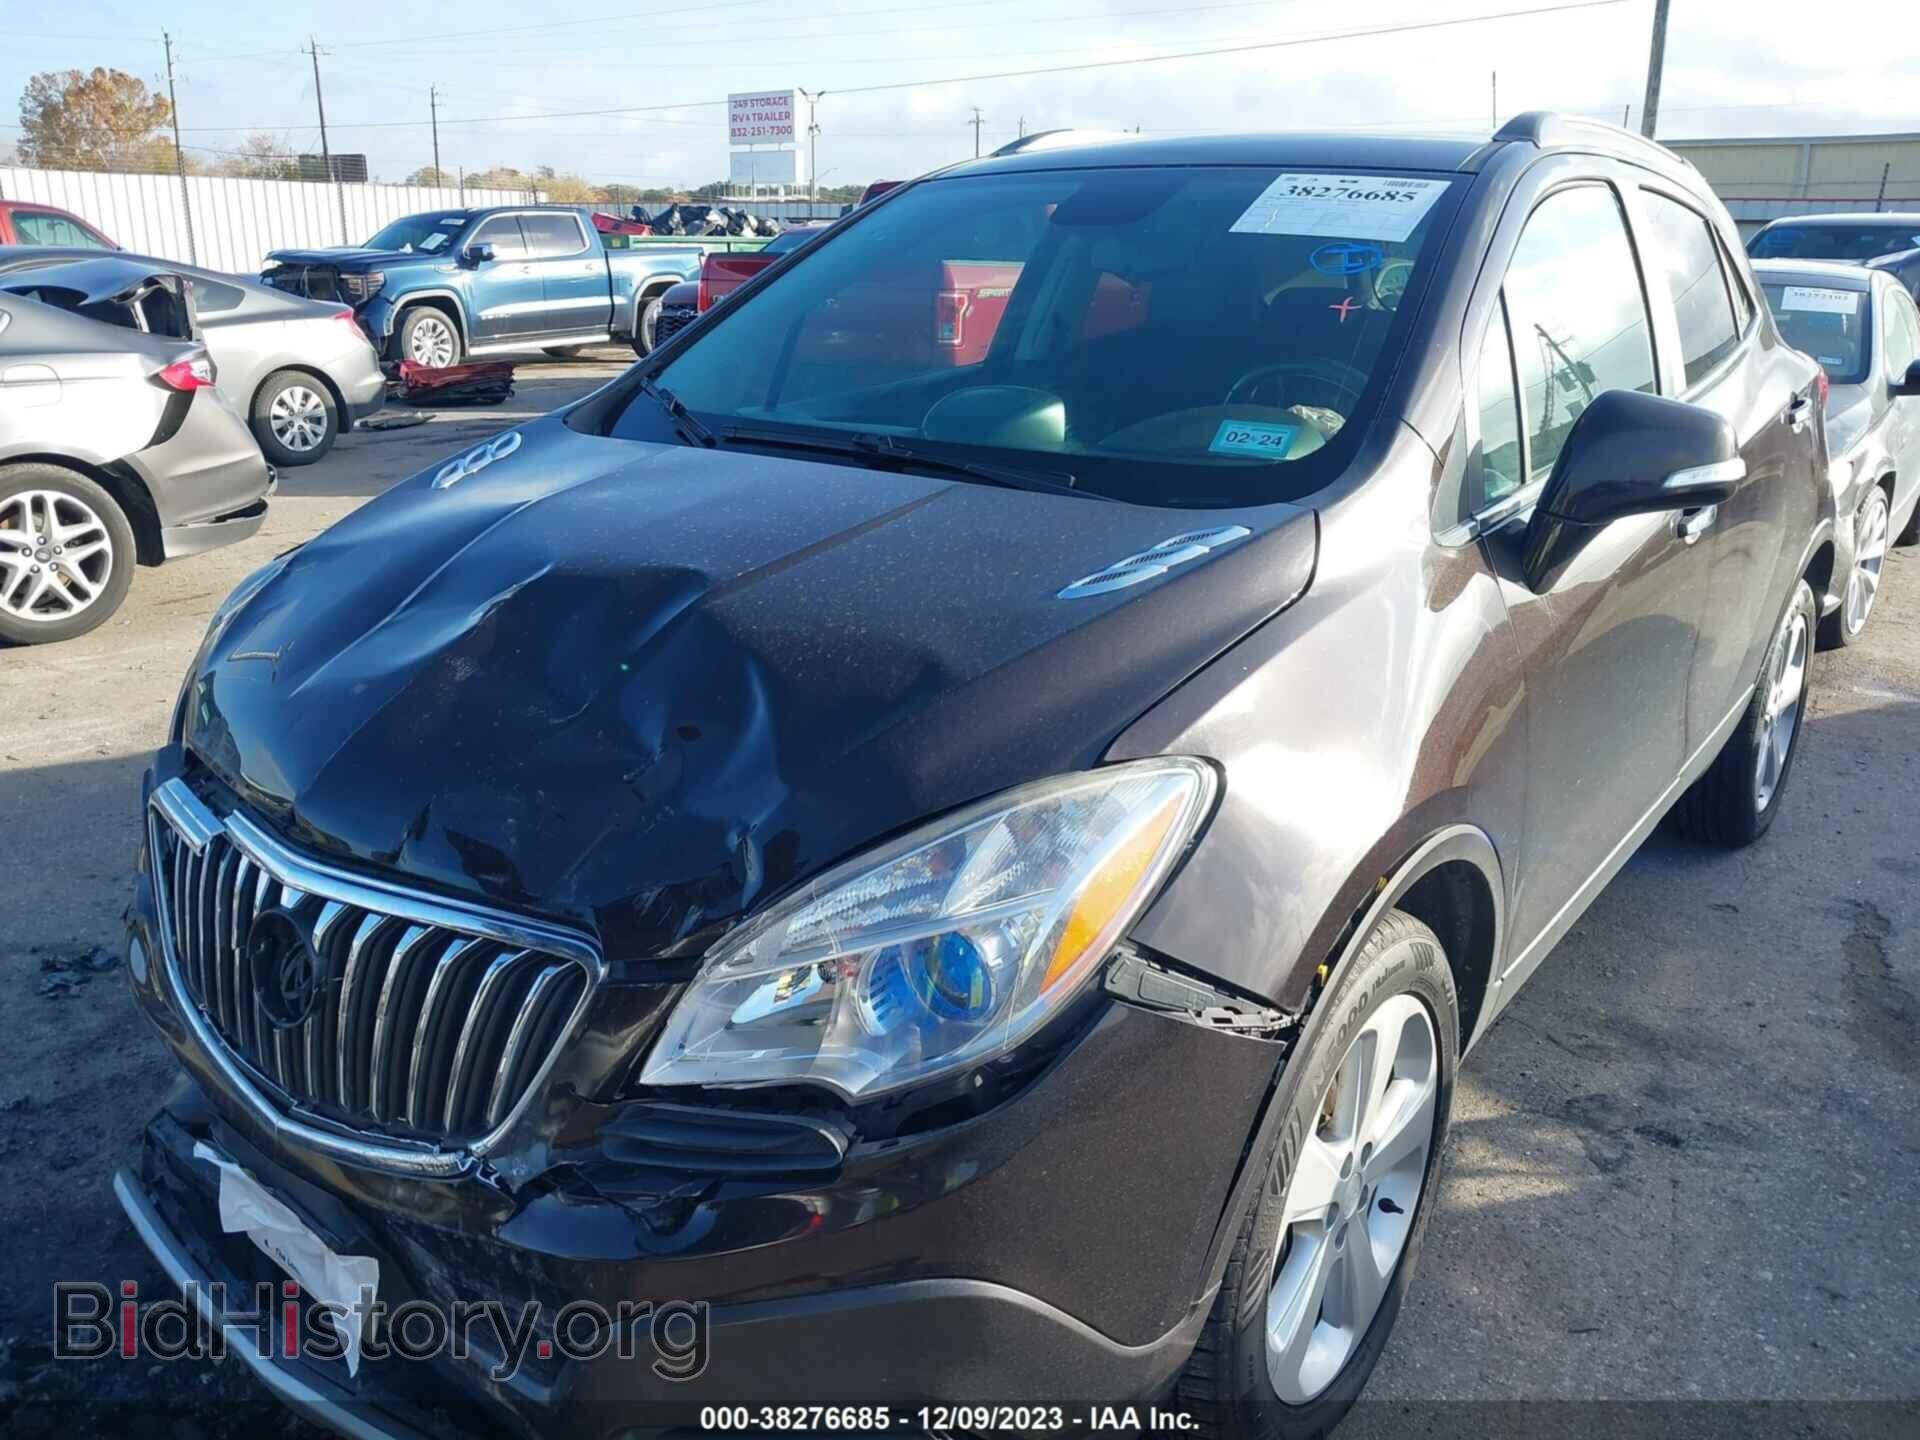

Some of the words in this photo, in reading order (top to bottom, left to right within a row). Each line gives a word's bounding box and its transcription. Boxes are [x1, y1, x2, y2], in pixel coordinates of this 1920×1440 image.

[749, 97, 788, 108] STORAGE
[732, 114, 745, 122] RV
[752, 111, 790, 122] TRAILER
[731, 126, 792, 137] 832-251-7300
[1279, 184, 1419, 203] 38276685
[1225, 431, 1250, 444] 02
[1257, 434, 1283, 447] 24
